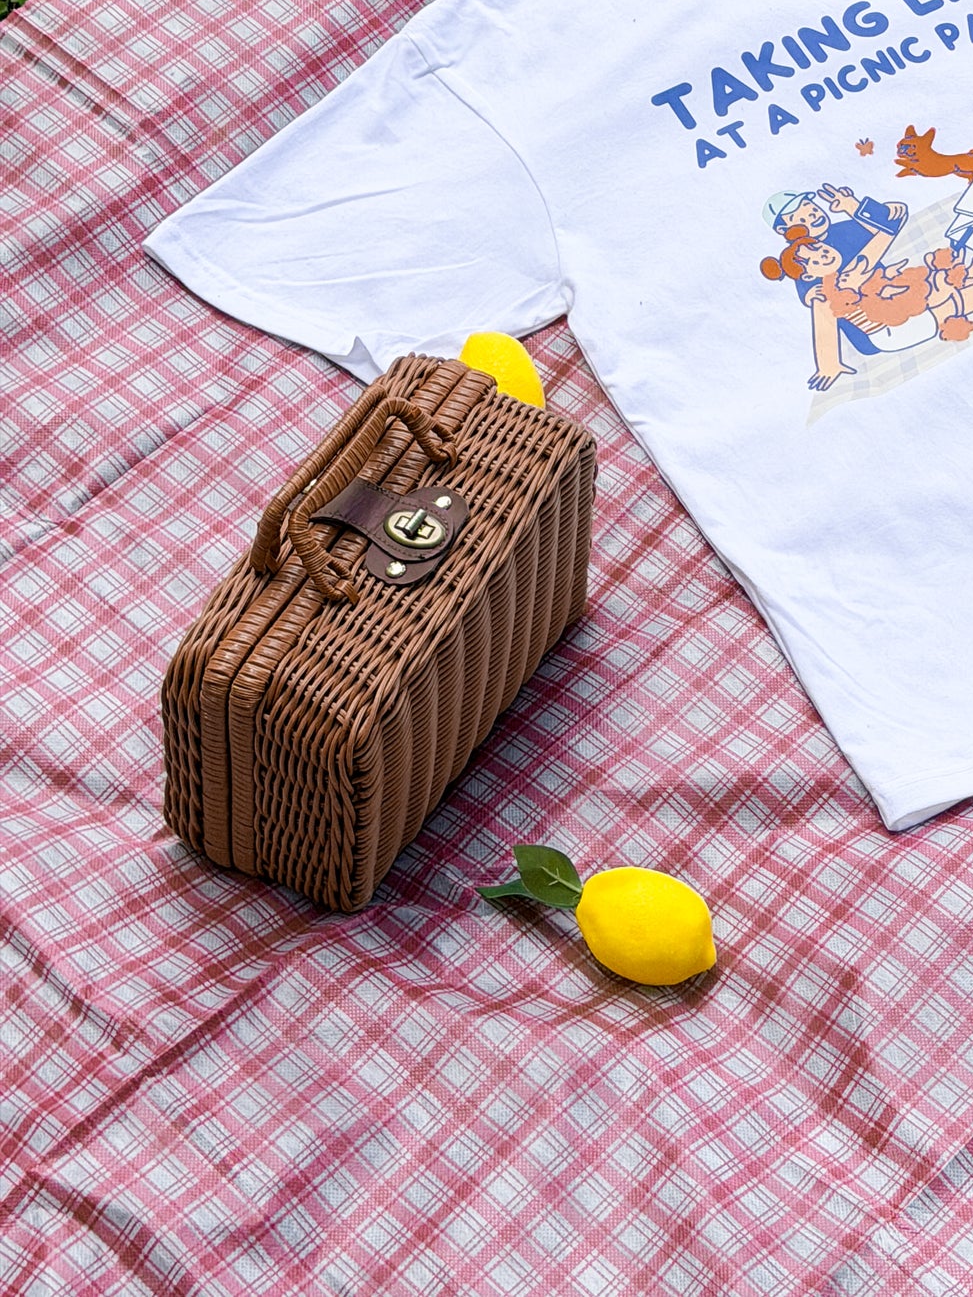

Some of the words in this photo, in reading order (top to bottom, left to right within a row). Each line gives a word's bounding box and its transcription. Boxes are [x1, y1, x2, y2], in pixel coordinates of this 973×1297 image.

[651, 1, 889, 130] TAKING
[696, 121, 747, 168] AT
[768, 104, 800, 135] A
[800, 37, 931, 112] PICNIC
